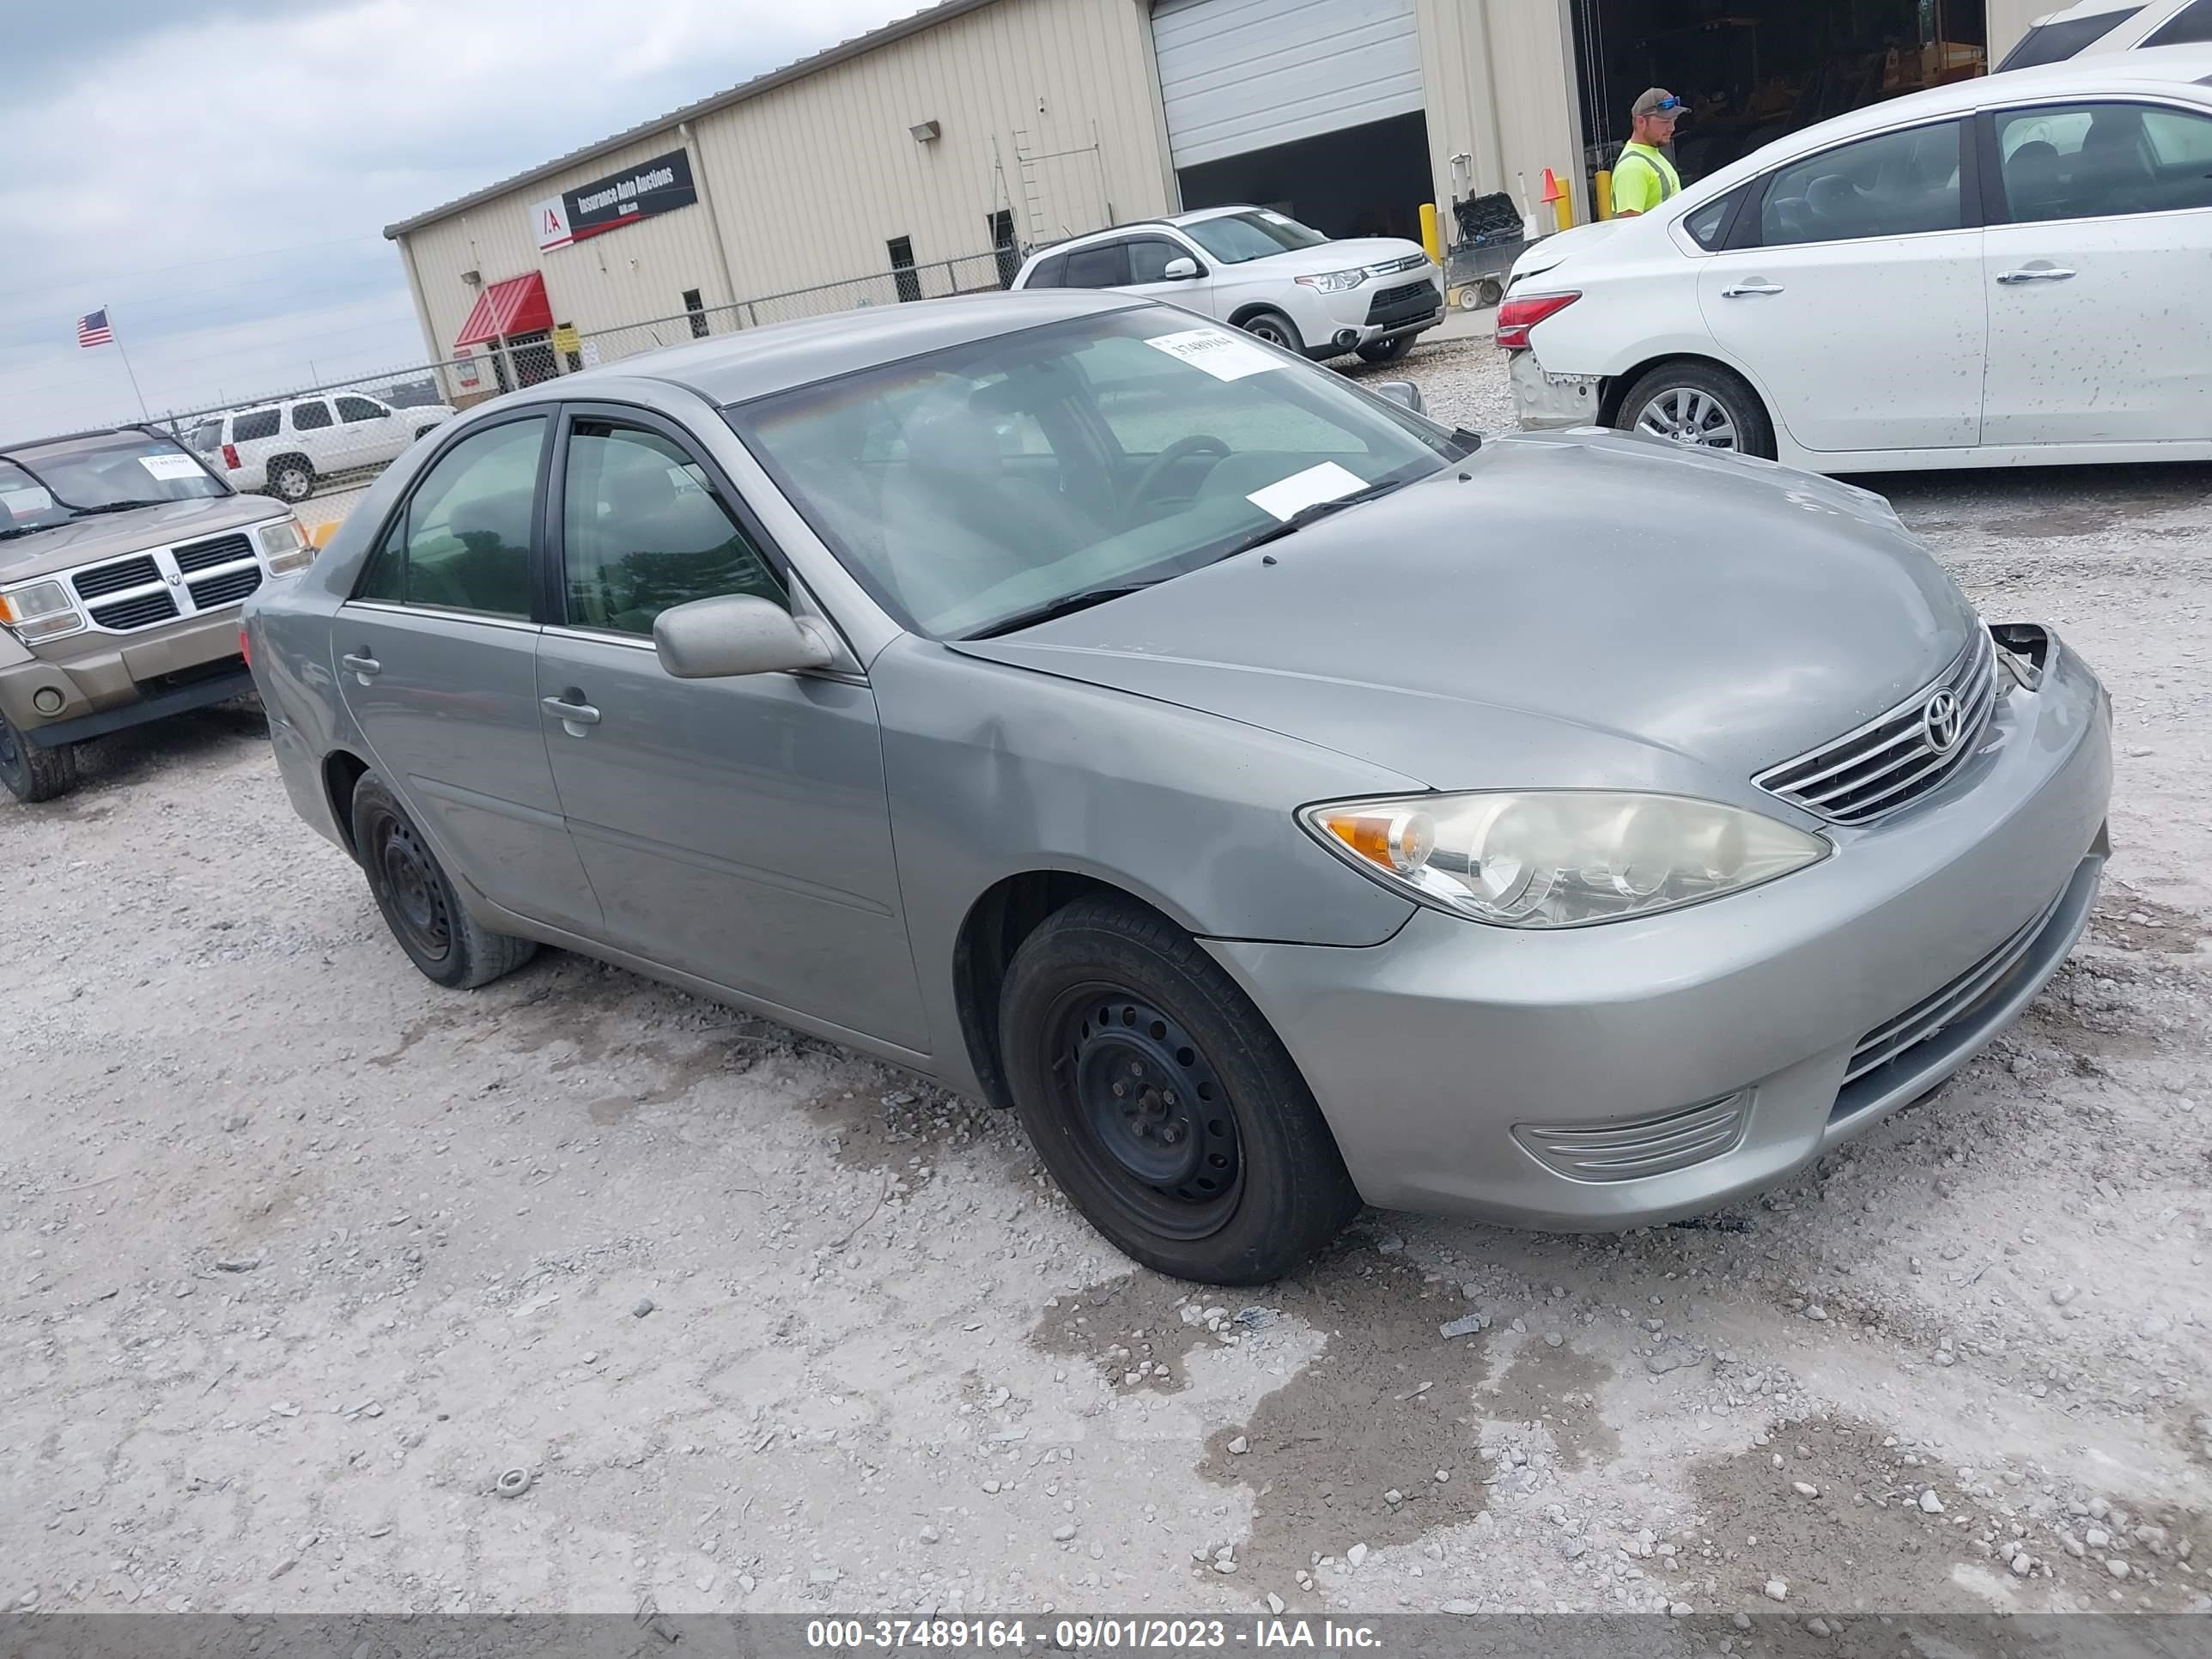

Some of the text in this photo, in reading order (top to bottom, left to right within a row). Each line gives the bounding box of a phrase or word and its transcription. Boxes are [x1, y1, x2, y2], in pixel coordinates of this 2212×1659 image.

[577, 167, 674, 215] Insurance Auto Auctions
